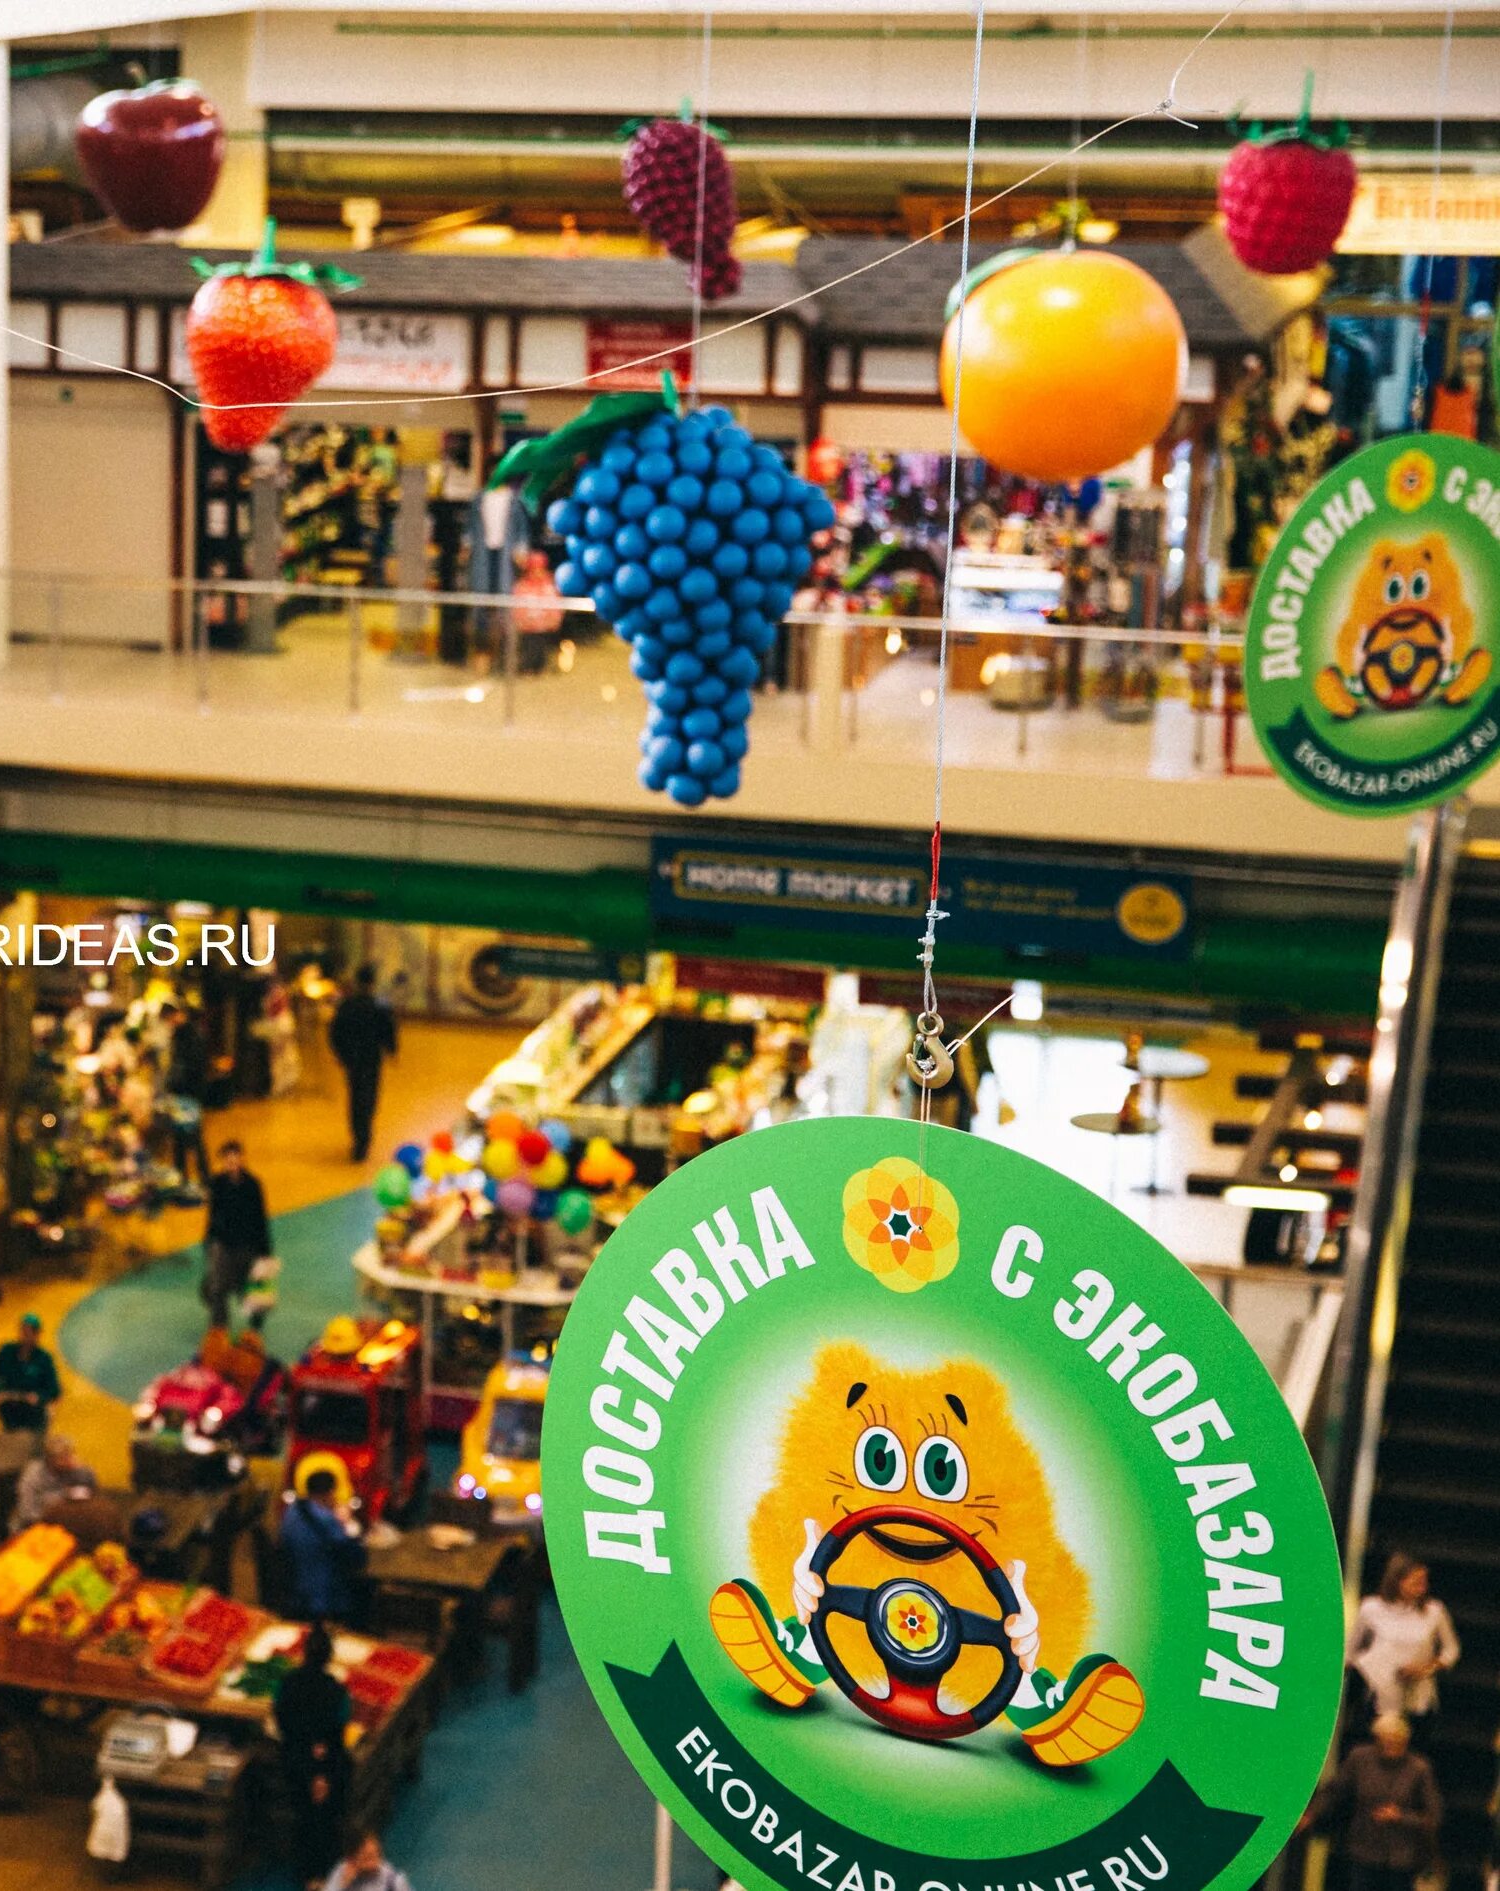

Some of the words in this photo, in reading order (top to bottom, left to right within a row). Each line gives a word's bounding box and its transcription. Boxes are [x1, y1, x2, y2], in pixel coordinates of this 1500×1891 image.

[1260, 476, 1376, 681] ДОСТАВКА
[1443, 466, 1468, 503] С
[582, 1185, 816, 1575] ДОСТАВКА
[989, 1224, 1045, 1299] С
[1053, 1268, 1286, 1711] ЭКОБАЗАРА
